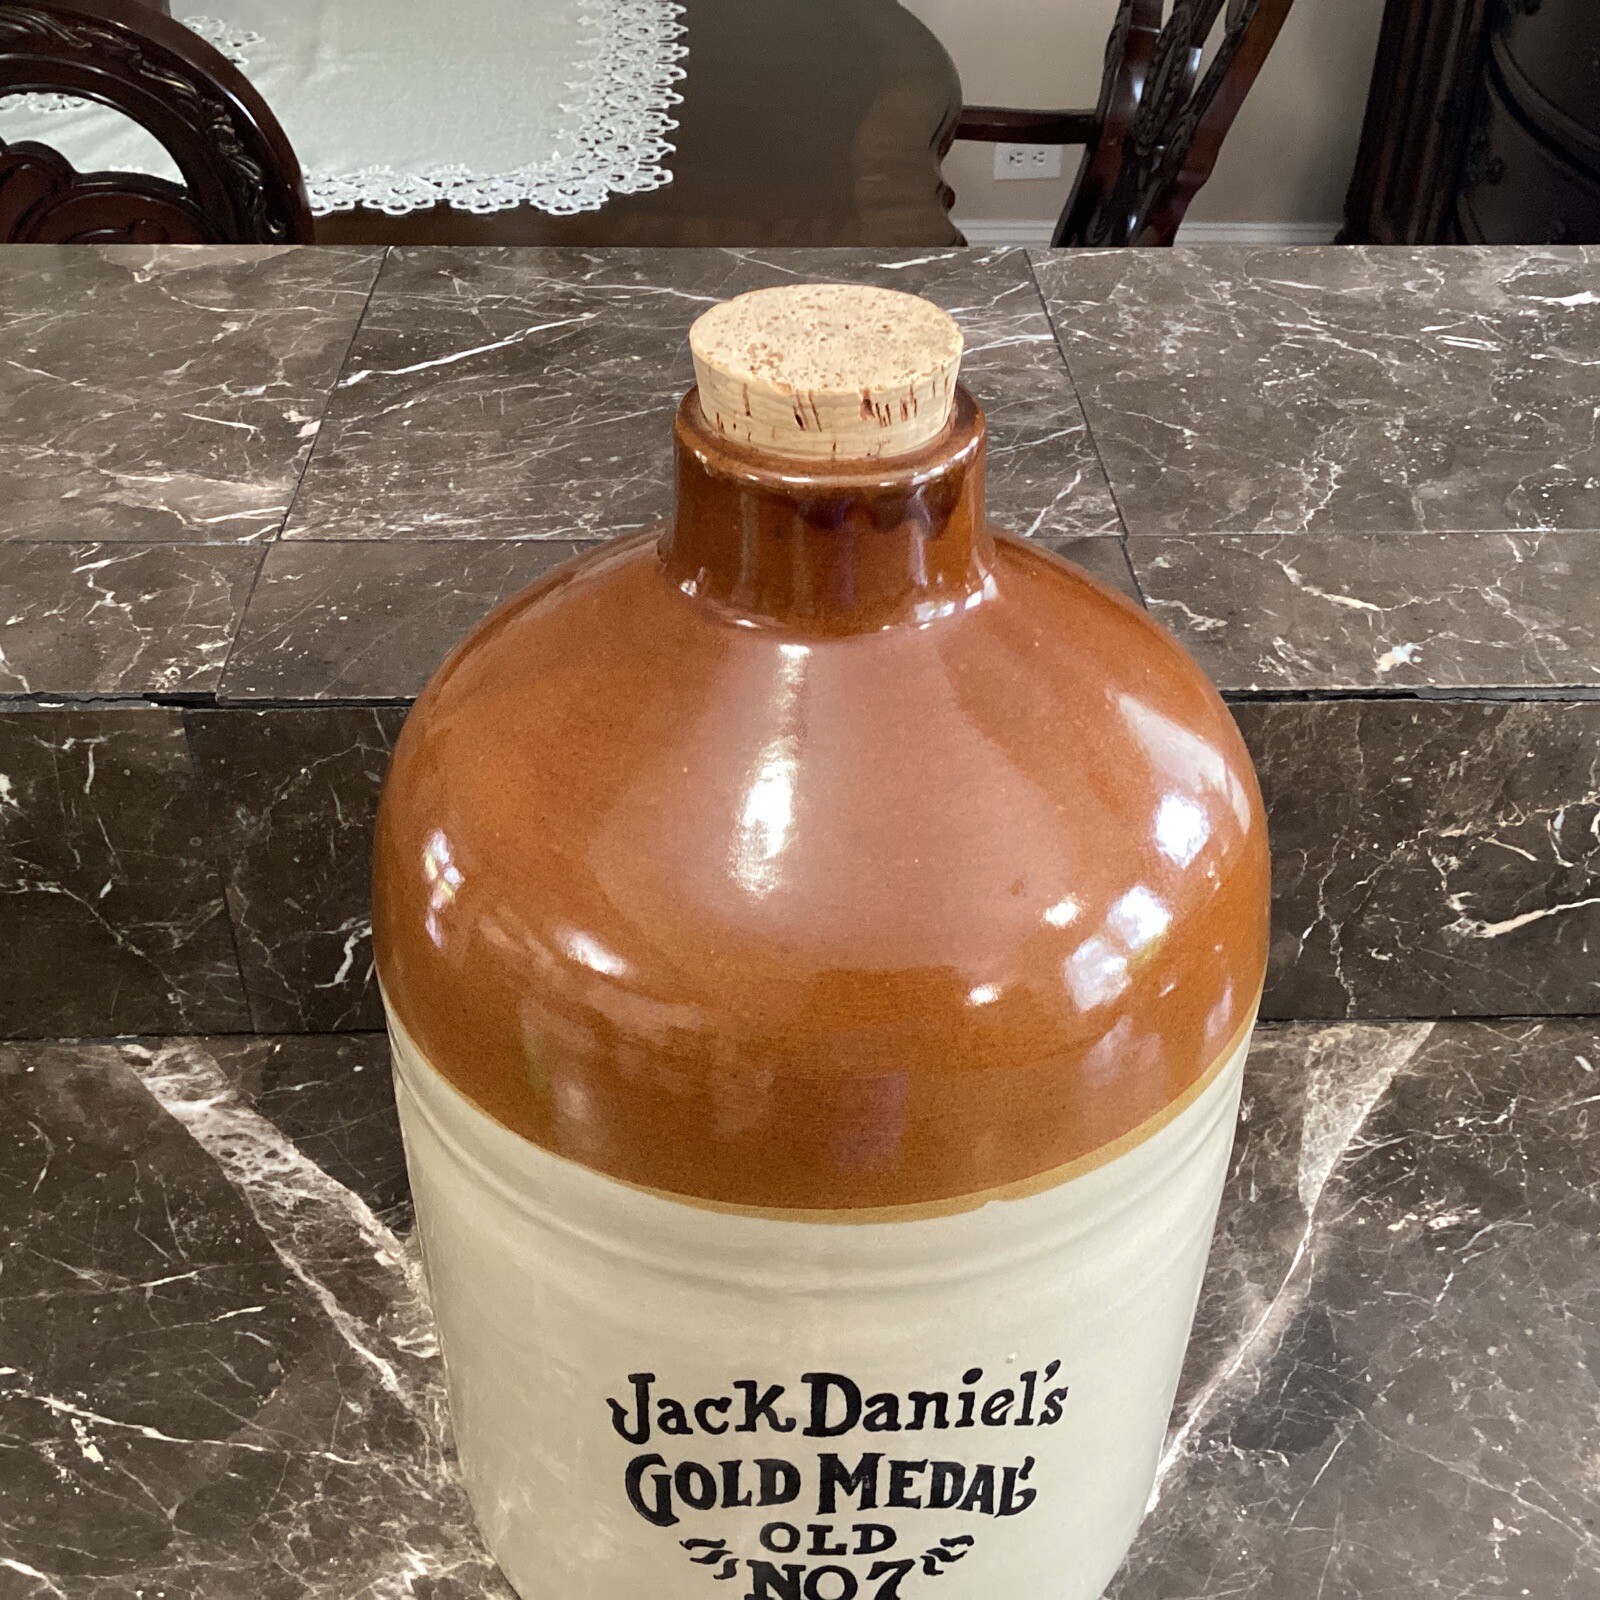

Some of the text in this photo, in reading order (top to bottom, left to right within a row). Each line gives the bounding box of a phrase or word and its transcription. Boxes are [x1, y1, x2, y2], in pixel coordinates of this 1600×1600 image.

[605, 1359, 1069, 1445] Jack Daniel's
[624, 1452, 1038, 1528] GOLD MEDAL
[759, 1521, 898, 1556] OLD
